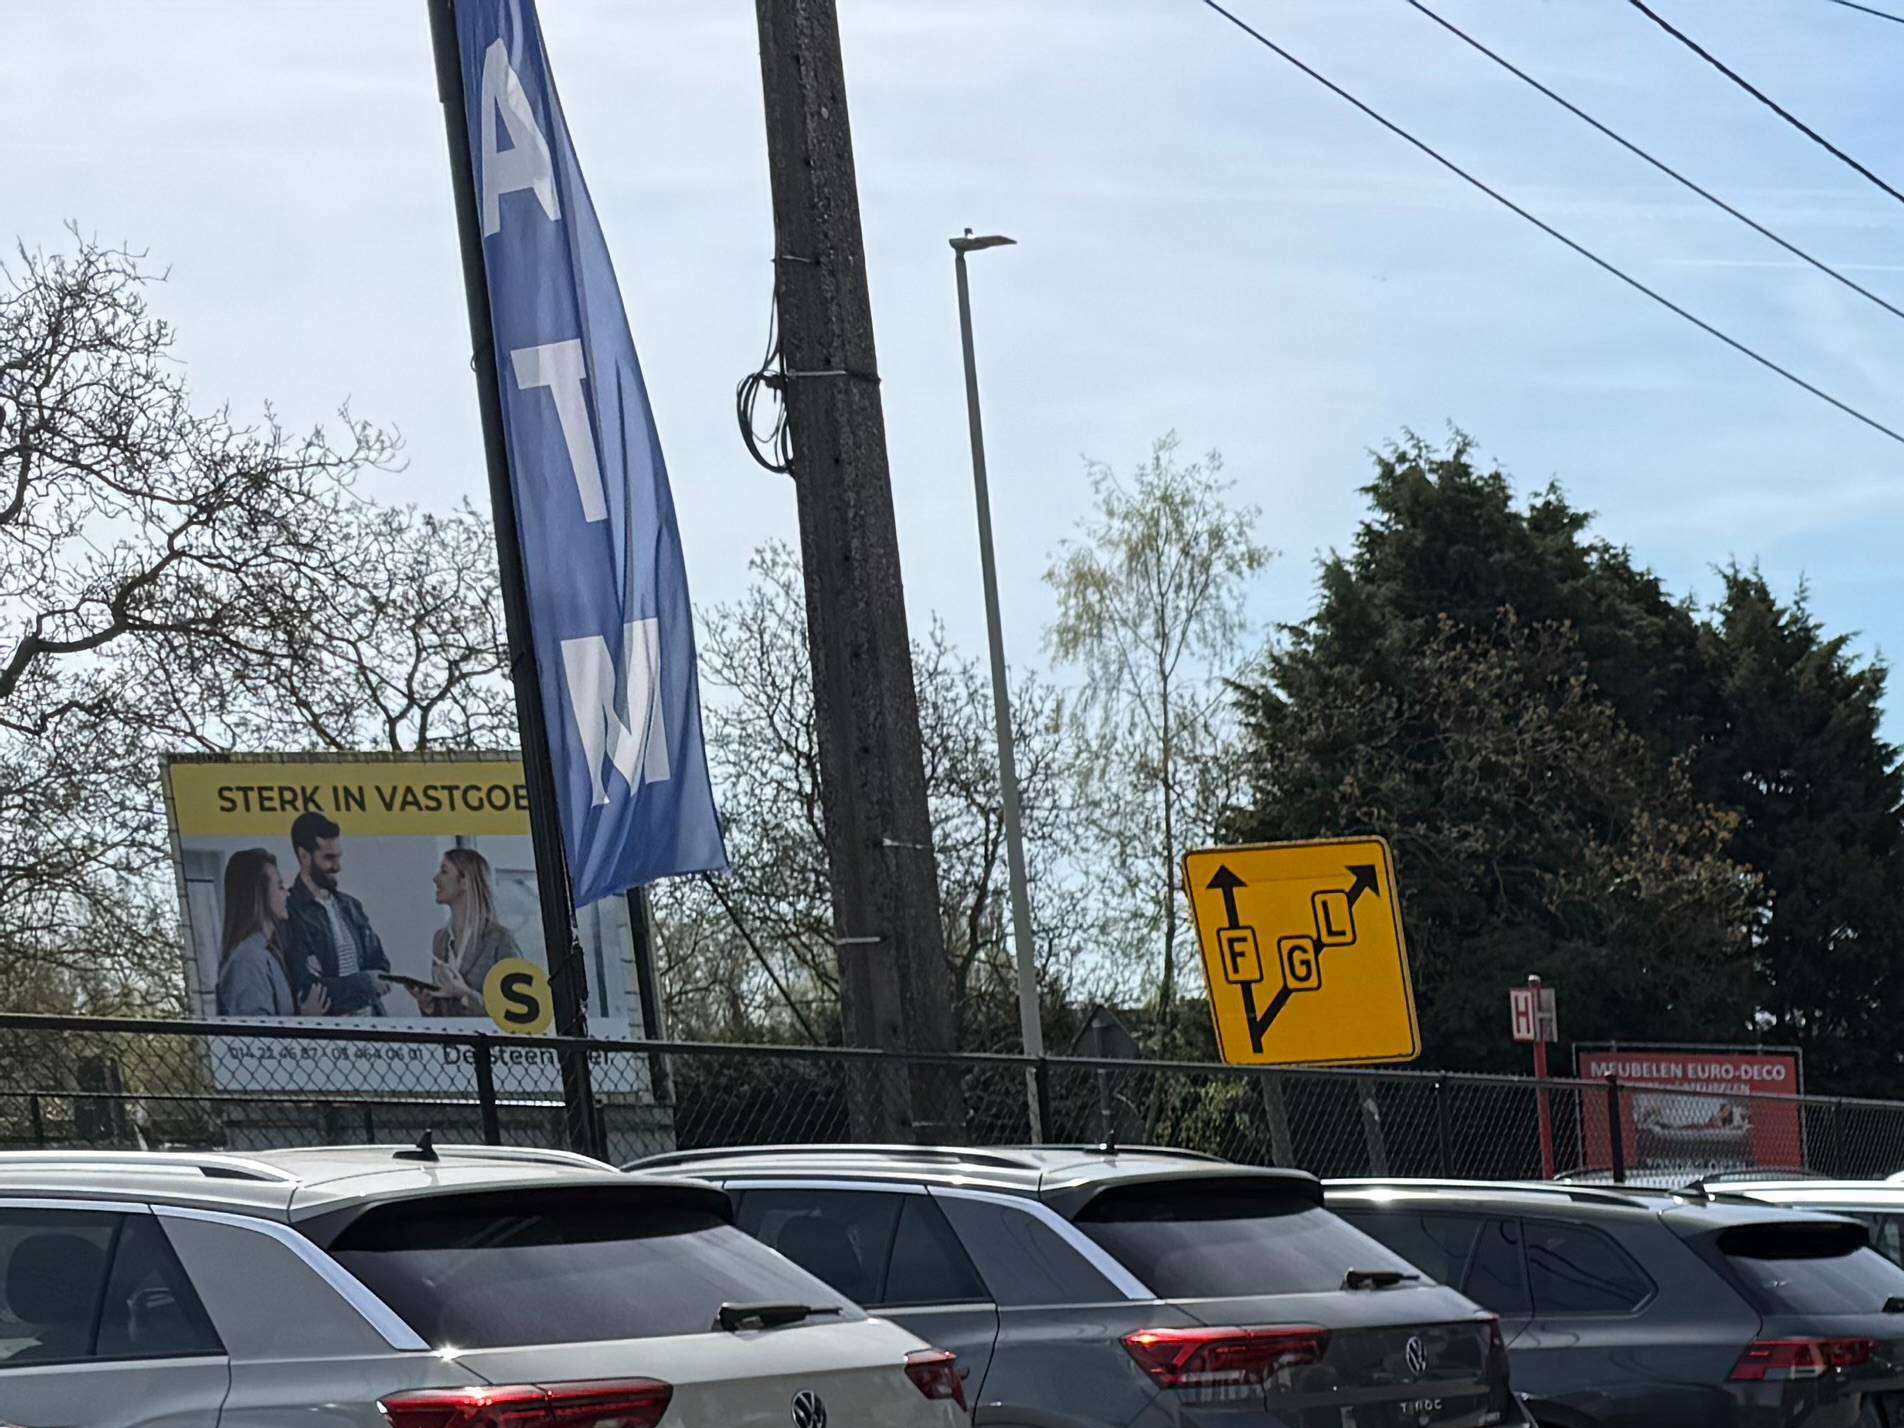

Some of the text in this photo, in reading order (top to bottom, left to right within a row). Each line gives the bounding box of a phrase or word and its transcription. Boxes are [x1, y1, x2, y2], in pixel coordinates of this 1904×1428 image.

[481, 36, 670, 806] ATM
[216, 783, 530, 812] STERK IN VASTGOE
[1320, 899, 1347, 937] L
[1226, 936, 1248, 975] F
[1286, 944, 1313, 982] G
[501, 972, 540, 1024] S
[1590, 1060, 1786, 1081] MEUBELEN EURO-DECO
